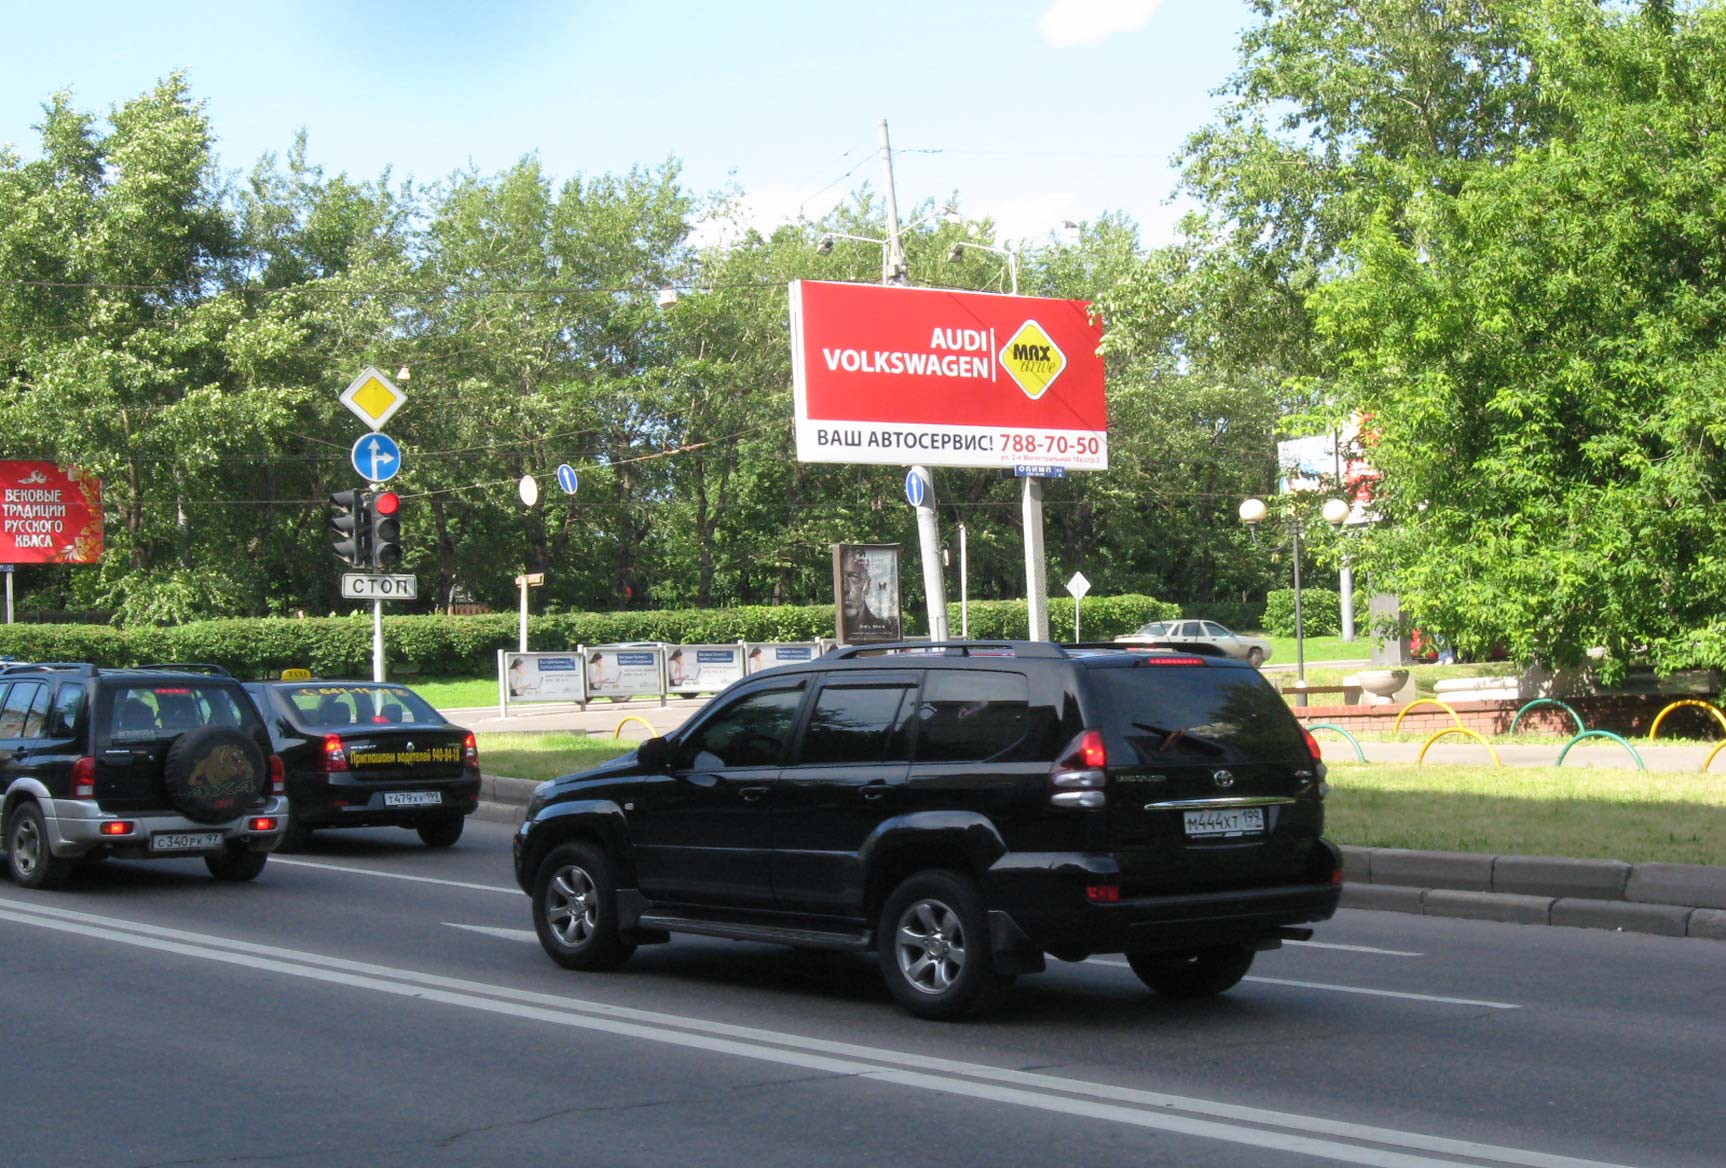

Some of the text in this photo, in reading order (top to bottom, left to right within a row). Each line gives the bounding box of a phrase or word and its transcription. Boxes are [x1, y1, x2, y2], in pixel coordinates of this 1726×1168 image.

[930, 327, 988, 352] AUDI
[1013, 343, 1051, 362] MAX
[822, 347, 989, 379] VOLKSWAGEN
[1020, 360, 1056, 374] drive
[817, 429, 1100, 455] ВАШ АВТОСЕРВИС! 788-70-50
[1018, 465, 1052, 473] ОЛИМП
[5, 489, 62, 502] ВЕКОВЫЕ
[2, 504, 66, 519] ТРАДИЦИИ
[4, 520, 64, 533] РУССКОГО
[15, 534, 54, 548] КВАСА
[353, 578, 408, 594] СТОП
[350, 751, 396, 767] Приглашаем
[397, 749, 431, 766] водителей
